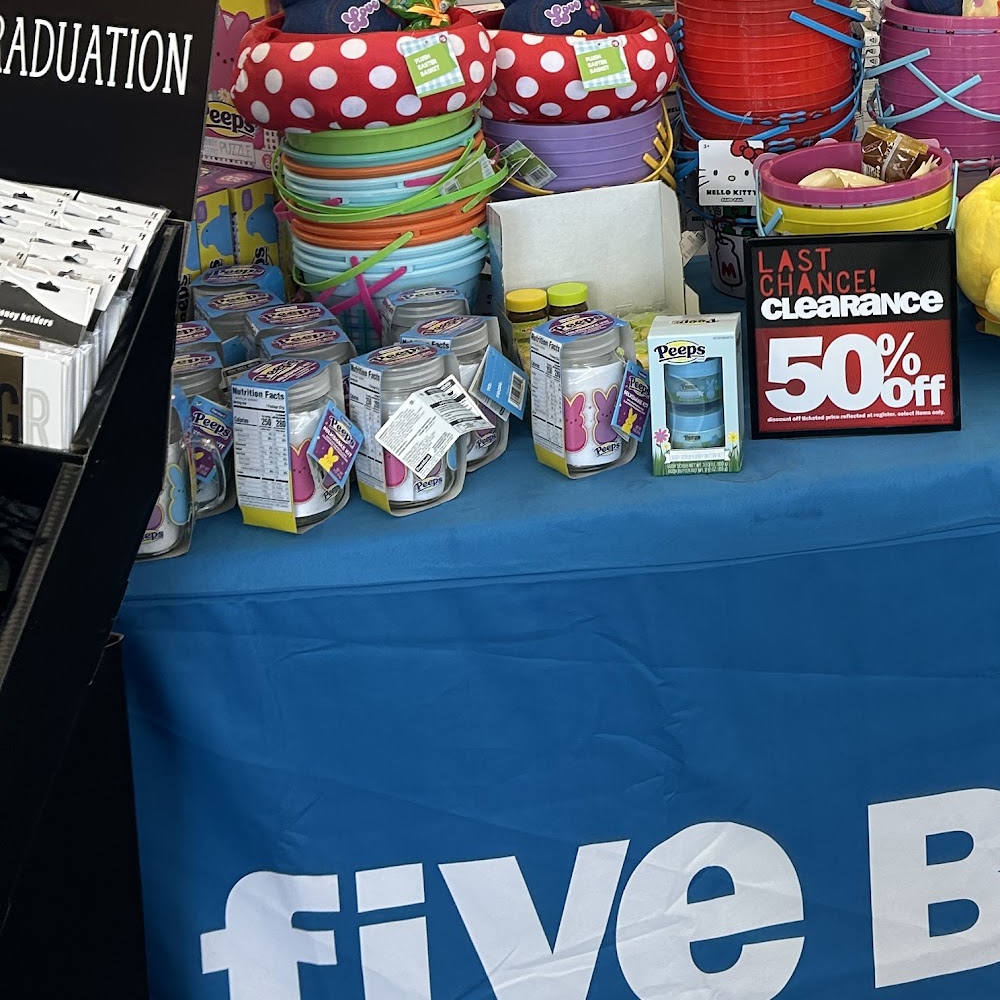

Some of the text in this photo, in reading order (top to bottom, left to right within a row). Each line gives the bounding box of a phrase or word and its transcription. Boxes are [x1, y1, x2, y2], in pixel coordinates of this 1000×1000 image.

[757, 247, 831, 274] LAST
[759, 268, 877, 298] CHANCE!
[653, 344, 706, 362] Peeps
[232, 386, 285, 401] Nutrition Facts
[193, 411, 231, 440] Peeps
[261, 417, 272, 426] 250
[802, 414, 825, 422] ticketed
[825, 414, 840, 422] price
[840, 412, 866, 420] reflected
[329, 415, 356, 450] Peeps
[594, 441, 621, 457] Peeps
[413, 475, 443, 492] Peeps
